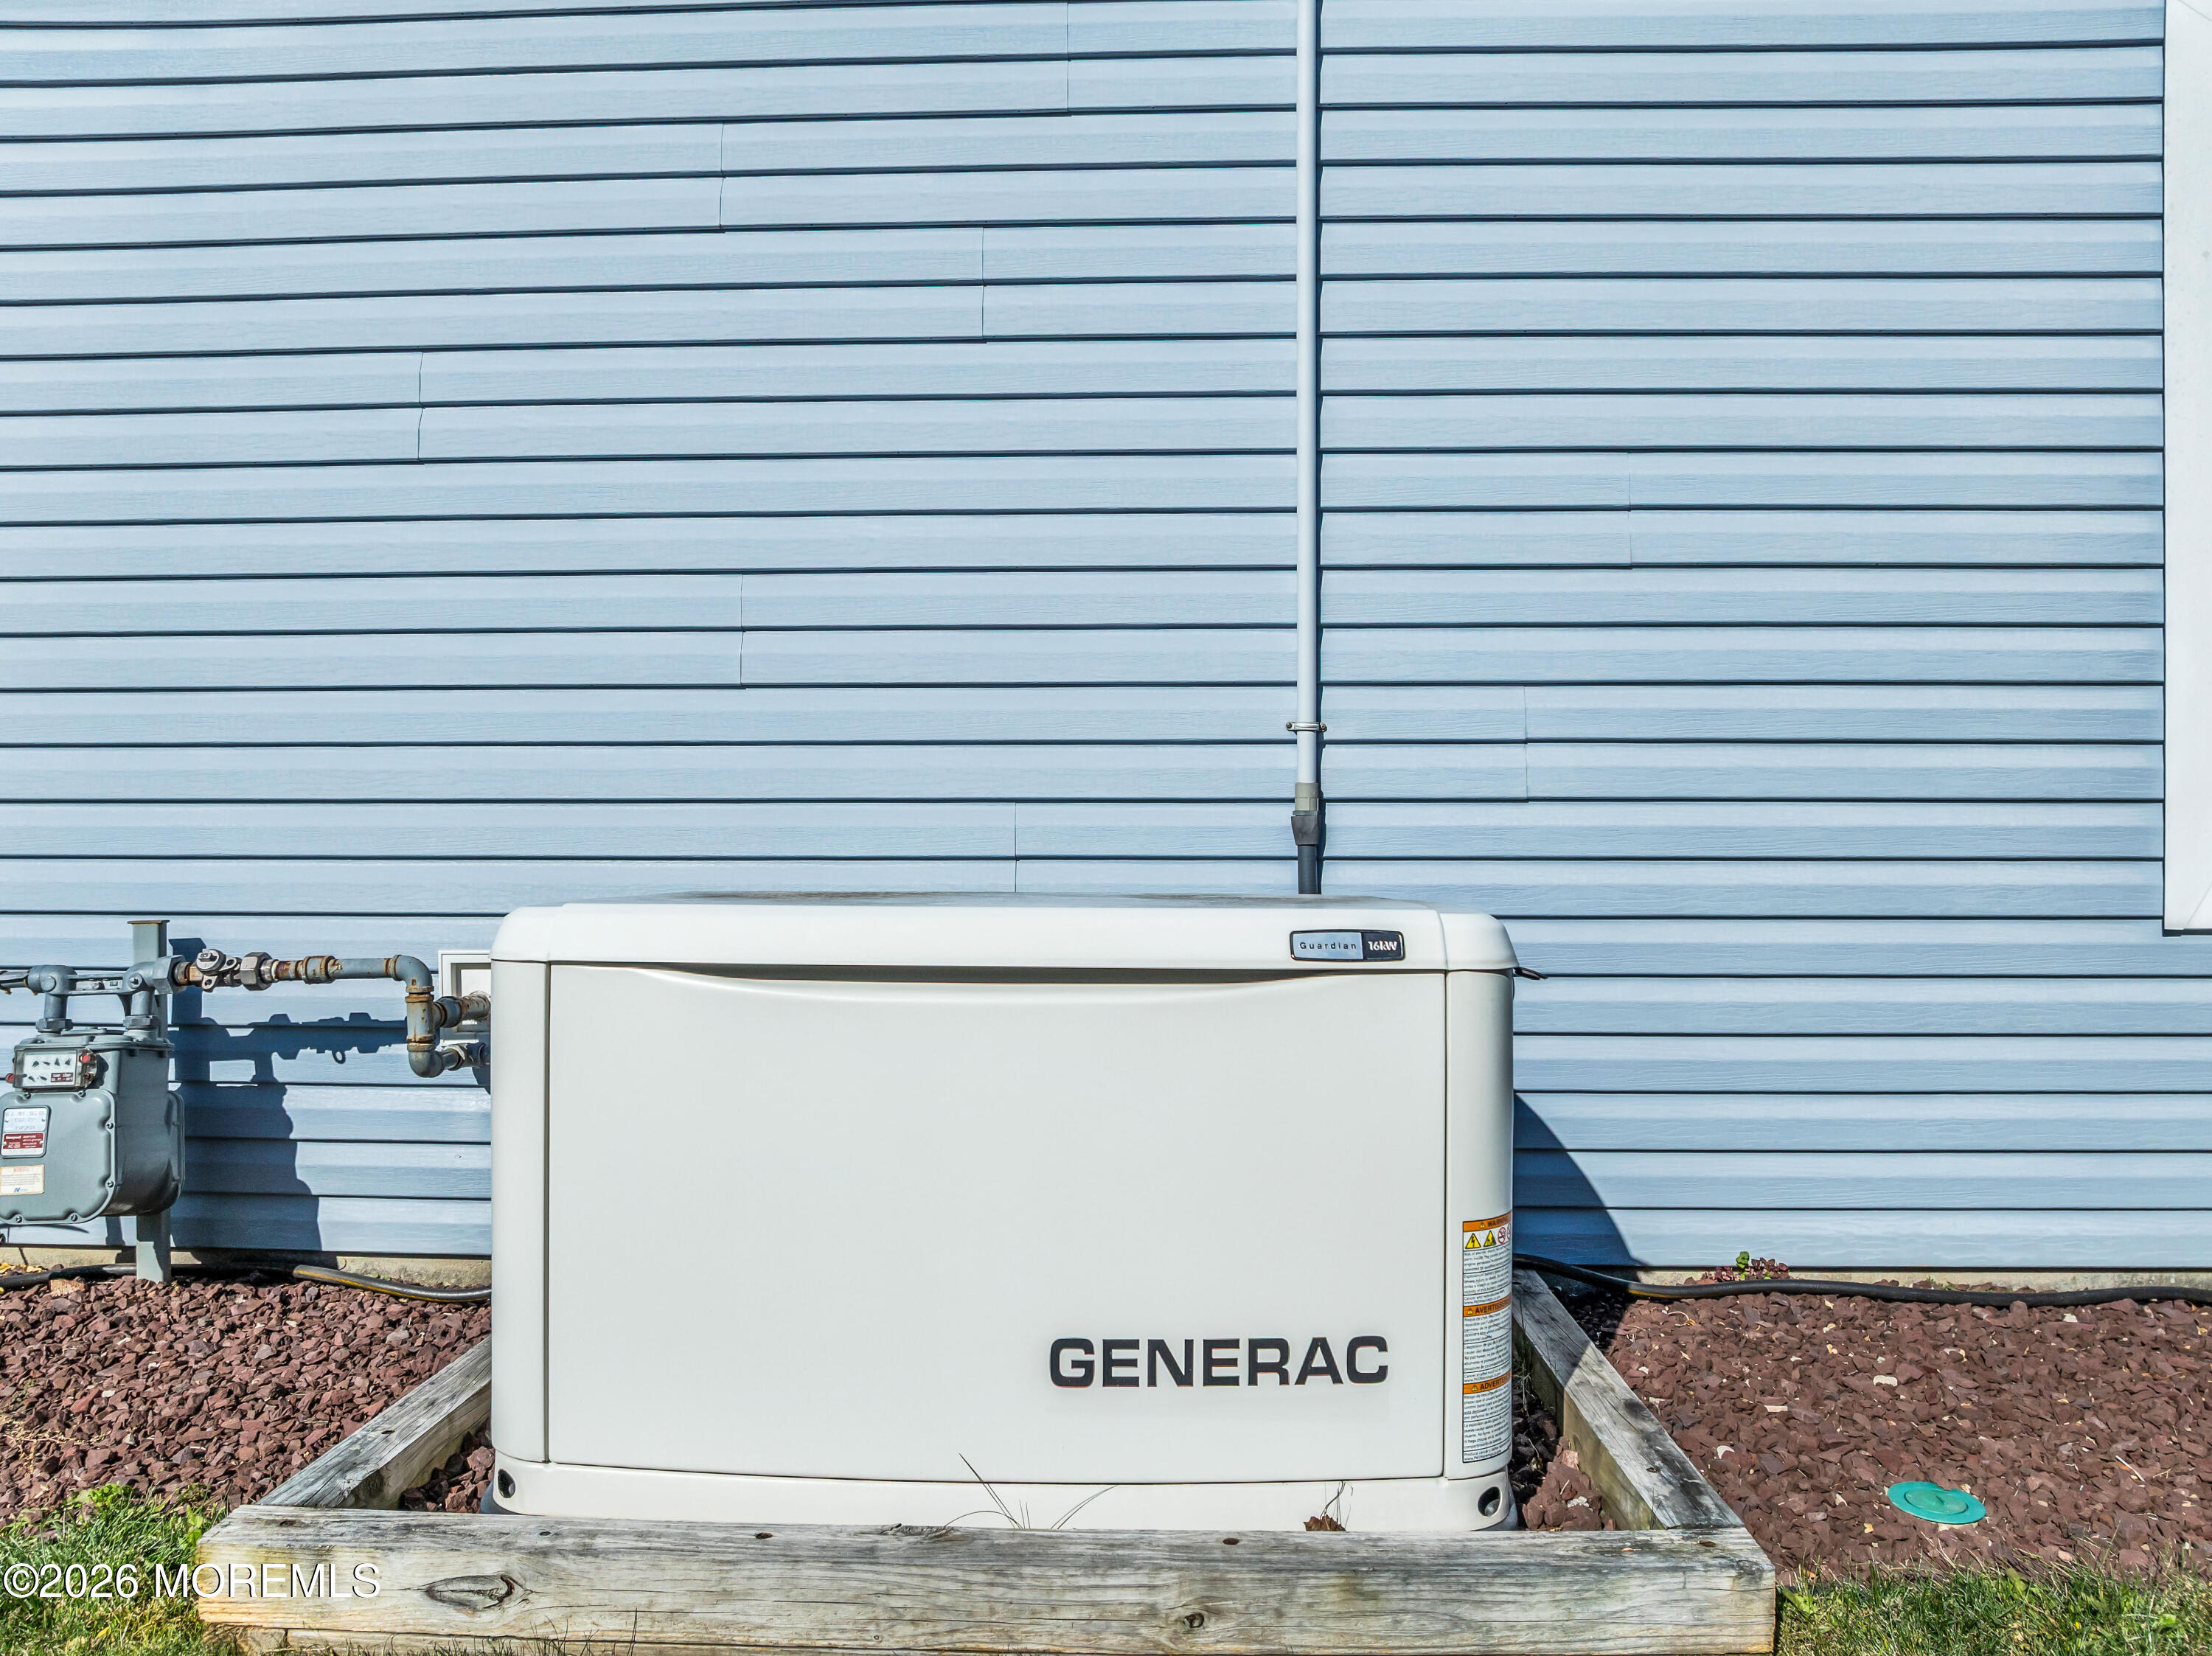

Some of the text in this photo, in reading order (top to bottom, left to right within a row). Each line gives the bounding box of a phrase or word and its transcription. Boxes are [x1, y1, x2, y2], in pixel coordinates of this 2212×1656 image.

[1299, 941, 1398, 951] Guardian 16kW
[1050, 1335, 1388, 1388] GENERAC
